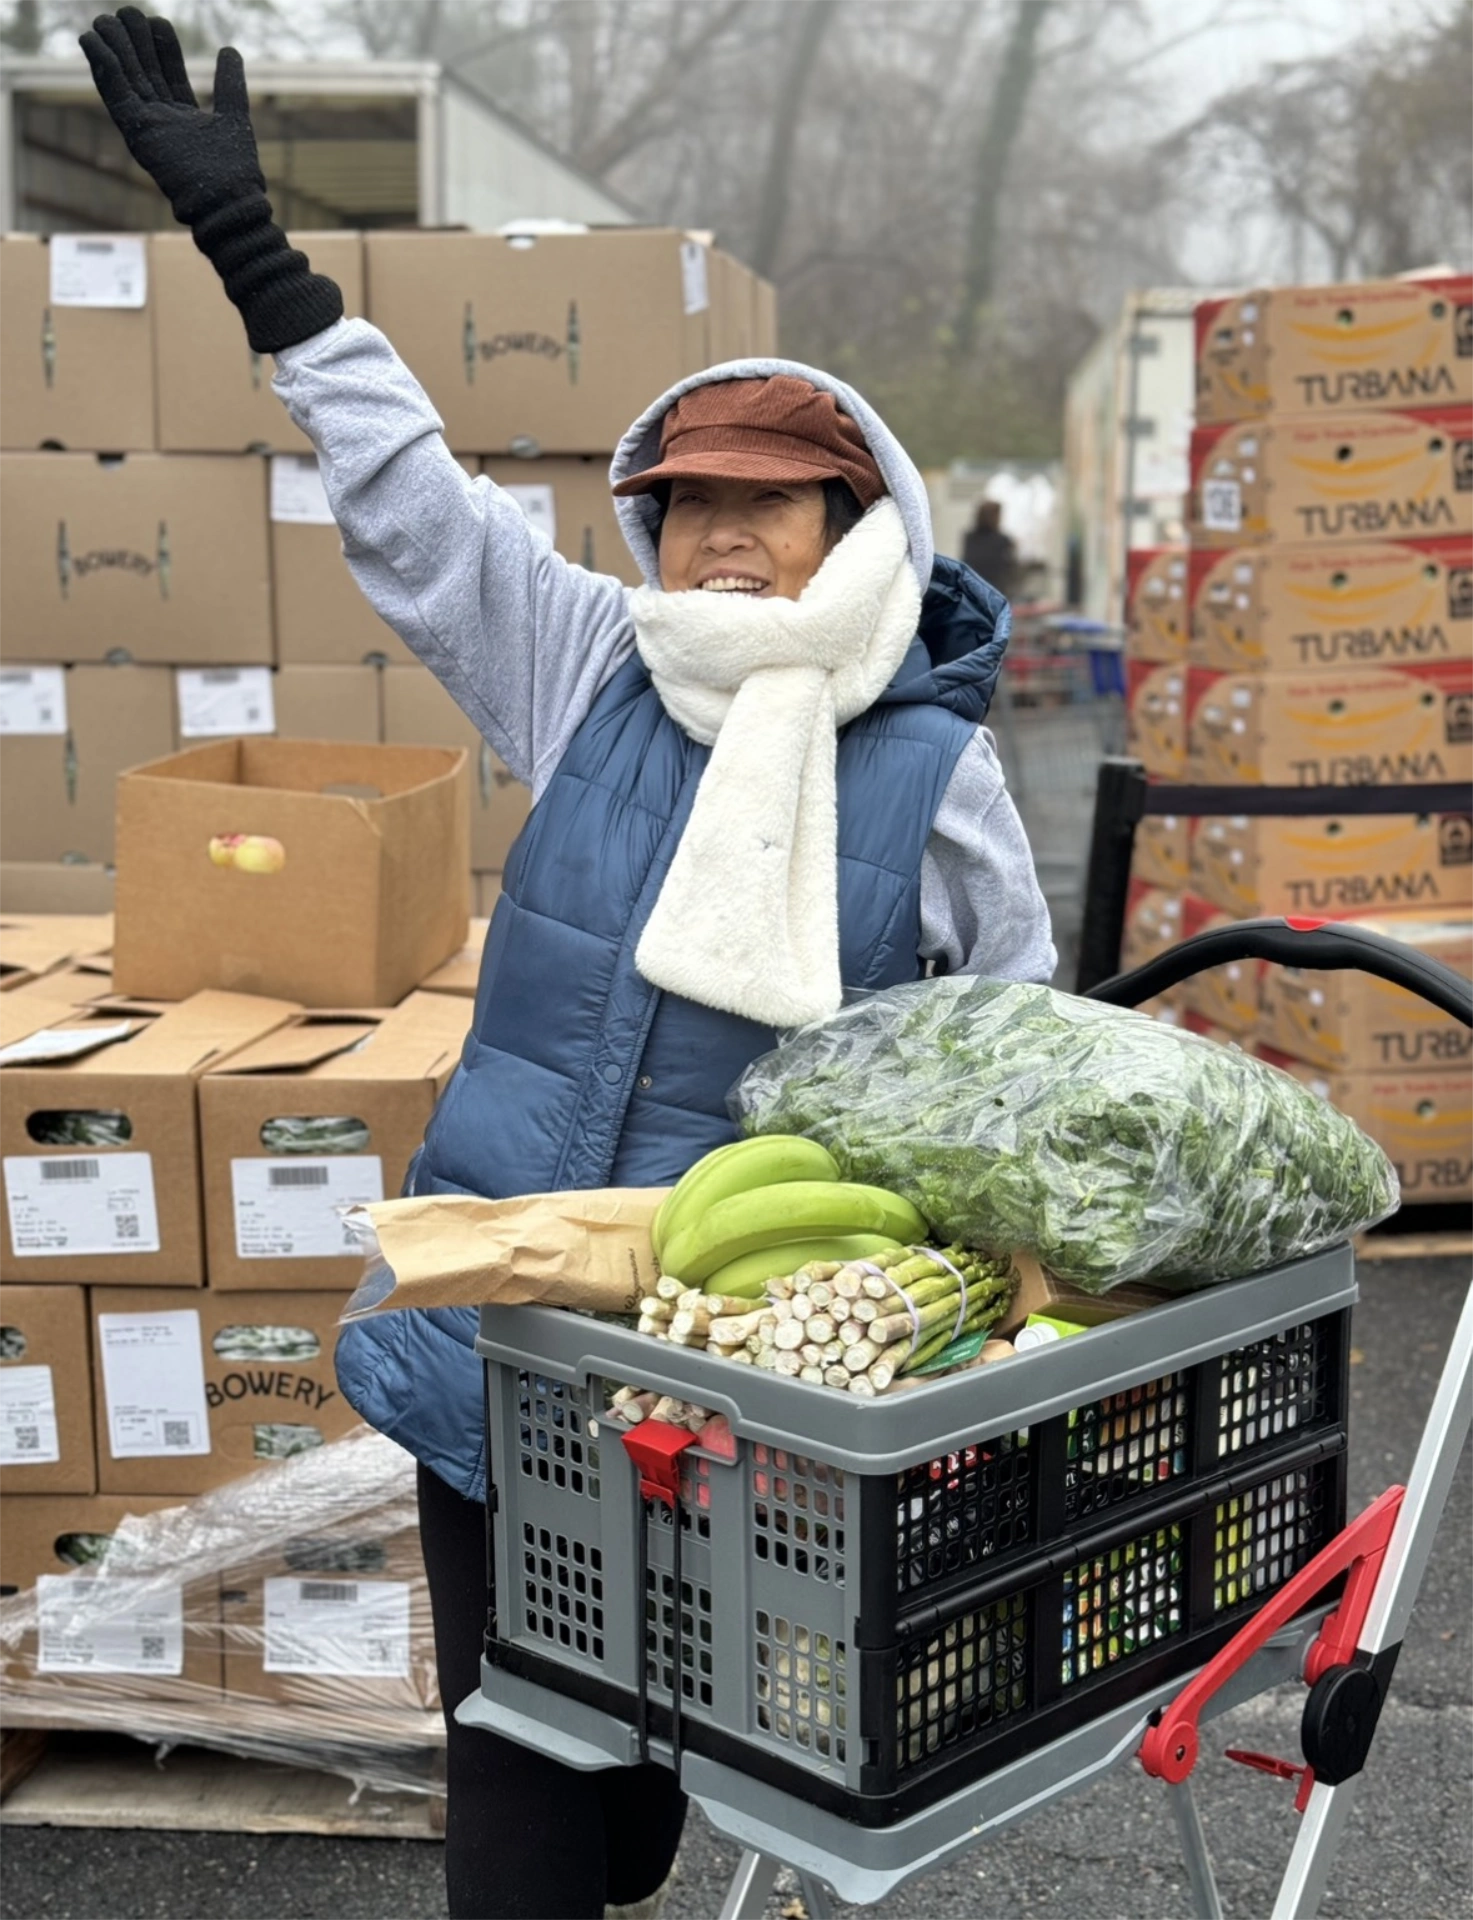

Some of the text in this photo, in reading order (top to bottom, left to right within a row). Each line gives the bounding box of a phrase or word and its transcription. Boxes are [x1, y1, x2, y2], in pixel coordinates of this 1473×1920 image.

[480, 332, 562, 361] BOWERY
[1296, 366, 1455, 405] TURBANA
[1296, 497, 1453, 536] TURBANA
[1291, 625, 1449, 663] TURBANA
[1289, 750, 1447, 786] TURBANA
[1285, 871, 1439, 908] TURBANA
[1395, 1158, 1473, 1189] URB
[206, 1370, 336, 1411] BOWERY
